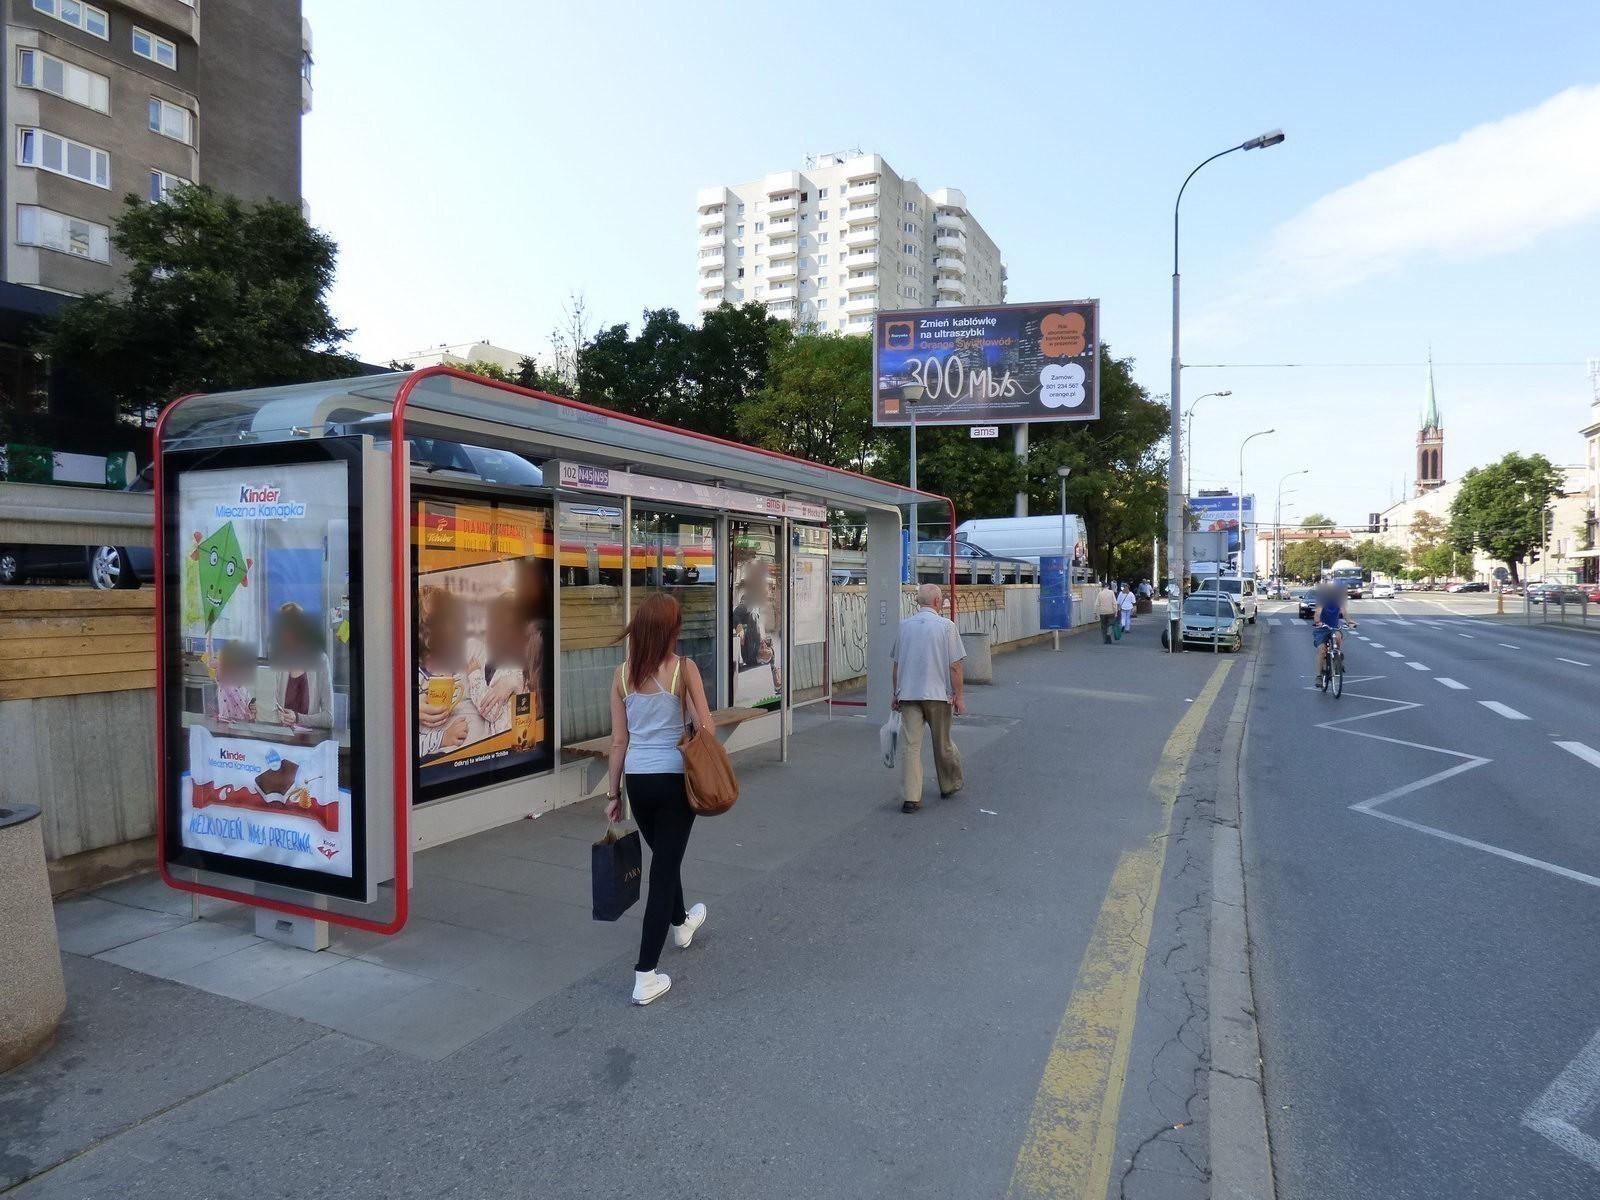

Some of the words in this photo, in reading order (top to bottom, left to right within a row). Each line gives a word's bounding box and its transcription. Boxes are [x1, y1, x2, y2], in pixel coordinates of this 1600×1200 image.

[920, 318, 950, 328] Zmień
[952, 316, 997, 326] kablówkę
[920, 331, 932, 339] na
[934, 327, 985, 338] ultraszybki
[920, 340, 955, 350] Orange
[903, 355, 964, 399] 300
[969, 366, 1017, 399] Mb/s
[973, 427, 996, 436] ams
[563, 465, 576, 479] 102
[578, 469, 593, 482] N45
[240, 486, 279, 502] Kinder
[766, 499, 781, 510] ams
[215, 504, 256, 518] Mieczna
[258, 503, 304, 519] Kanapka
[220, 748, 246, 761] Kinder
